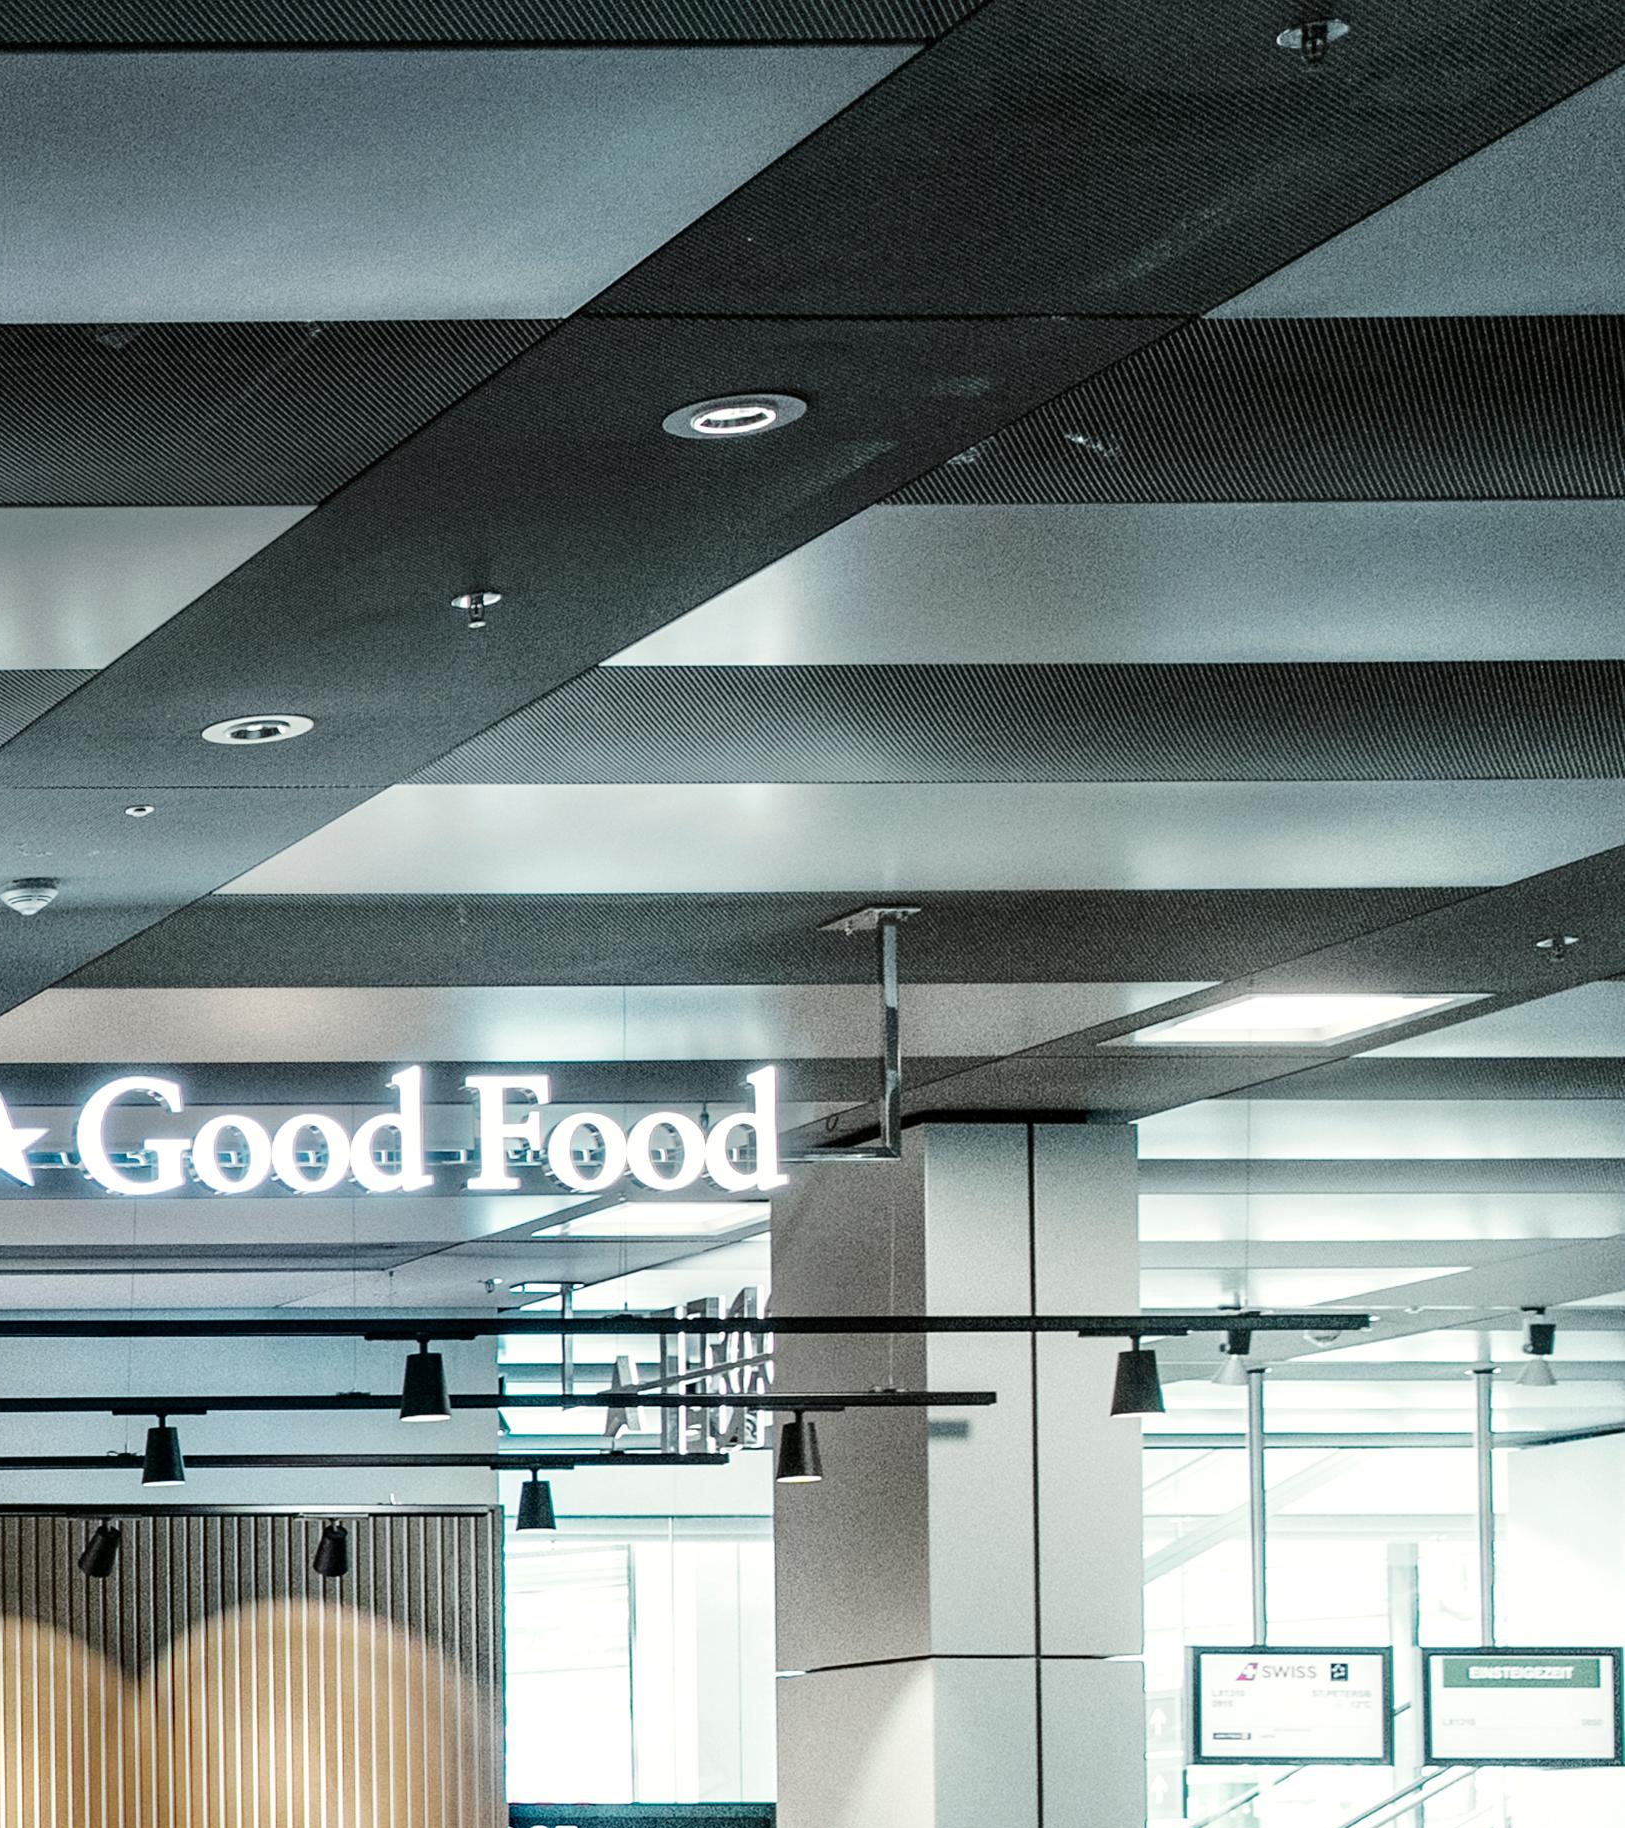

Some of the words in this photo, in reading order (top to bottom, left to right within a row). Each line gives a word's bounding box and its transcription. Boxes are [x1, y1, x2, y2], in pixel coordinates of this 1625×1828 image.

[75, 1065, 434, 1196] Good
[464, 1065, 790, 1194] Food
[1261, 1665, 1318, 1679] SWISS
